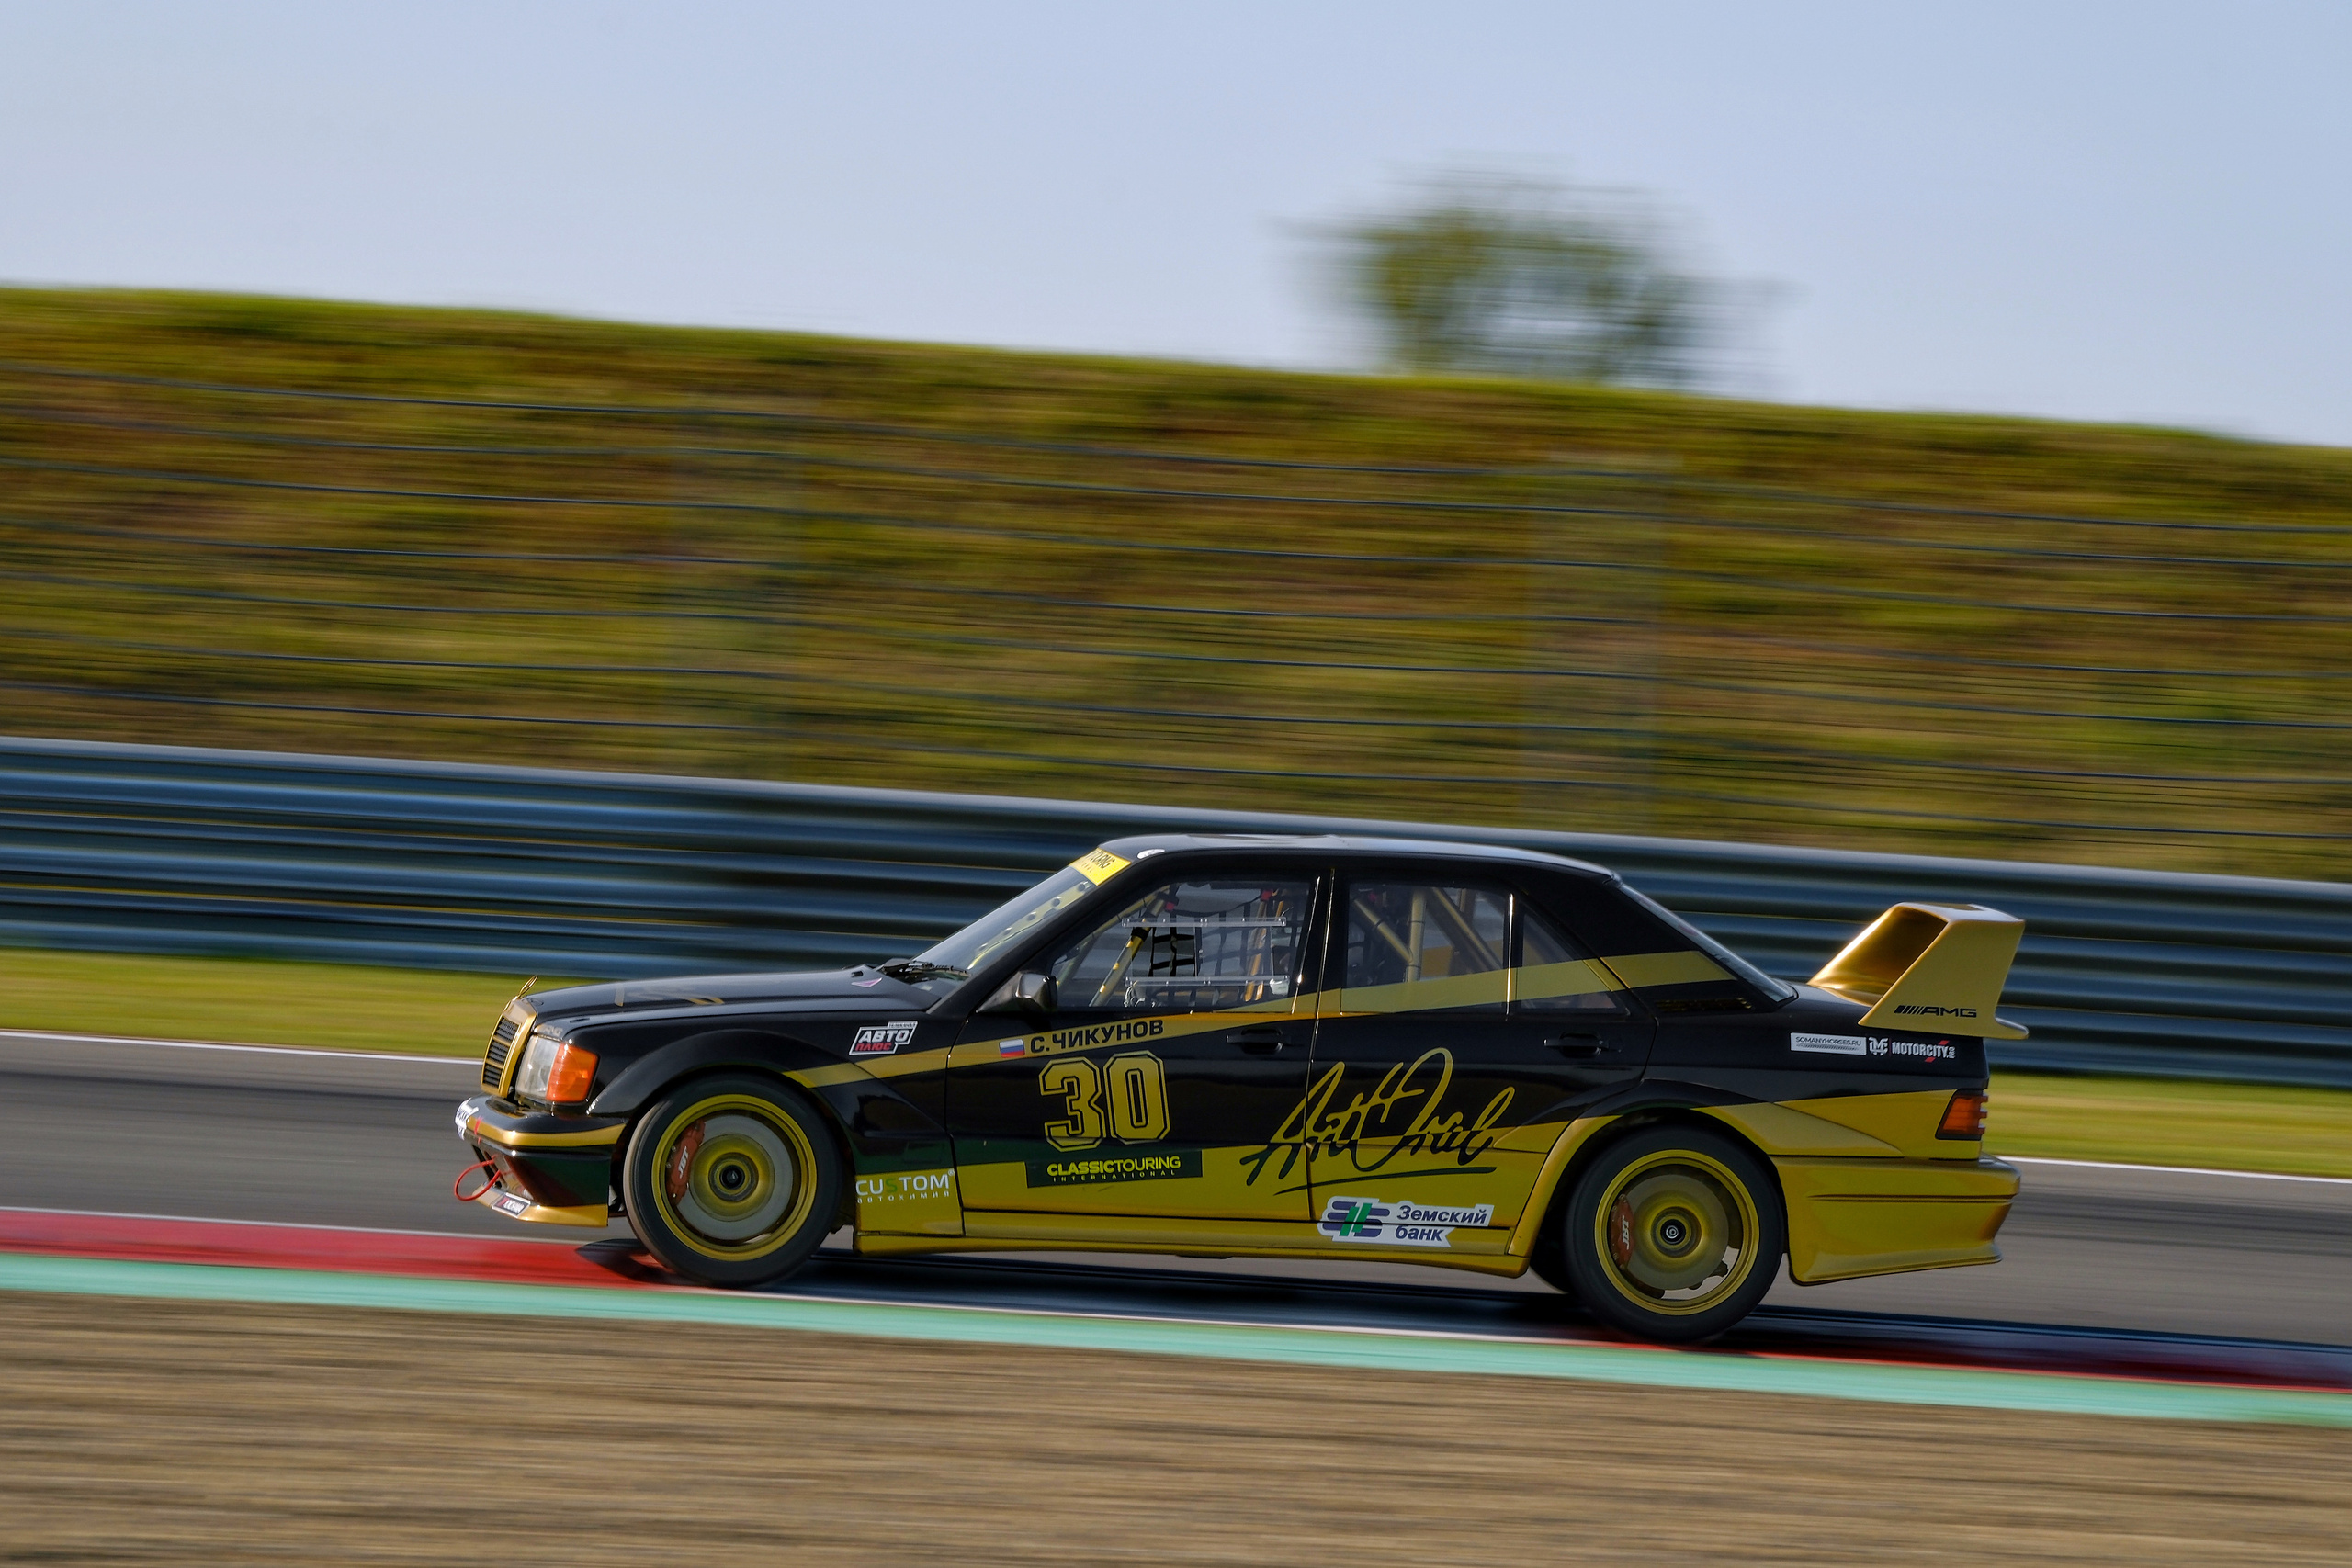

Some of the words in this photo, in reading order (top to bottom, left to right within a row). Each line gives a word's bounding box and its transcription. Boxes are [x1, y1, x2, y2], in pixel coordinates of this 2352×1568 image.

[1920, 1006, 1977, 1018] AMG
[858, 1029, 910, 1043] АВТО
[1795, 1036, 1862, 1046] SOMANYHORSES.RU
[855, 1043, 892, 1051] ПЛЮС
[1038, 1049, 1171, 1152] 30
[678, 1145, 689, 1179] JBT
[1046, 1156, 1181, 1176] CLASSICTOURING
[1052, 1169, 1175, 1182] INTERNATIONAL
[1396, 1204, 1487, 1224] Земский
[1395, 1224, 1444, 1242] банк
[1622, 1214, 1630, 1250] JBT
